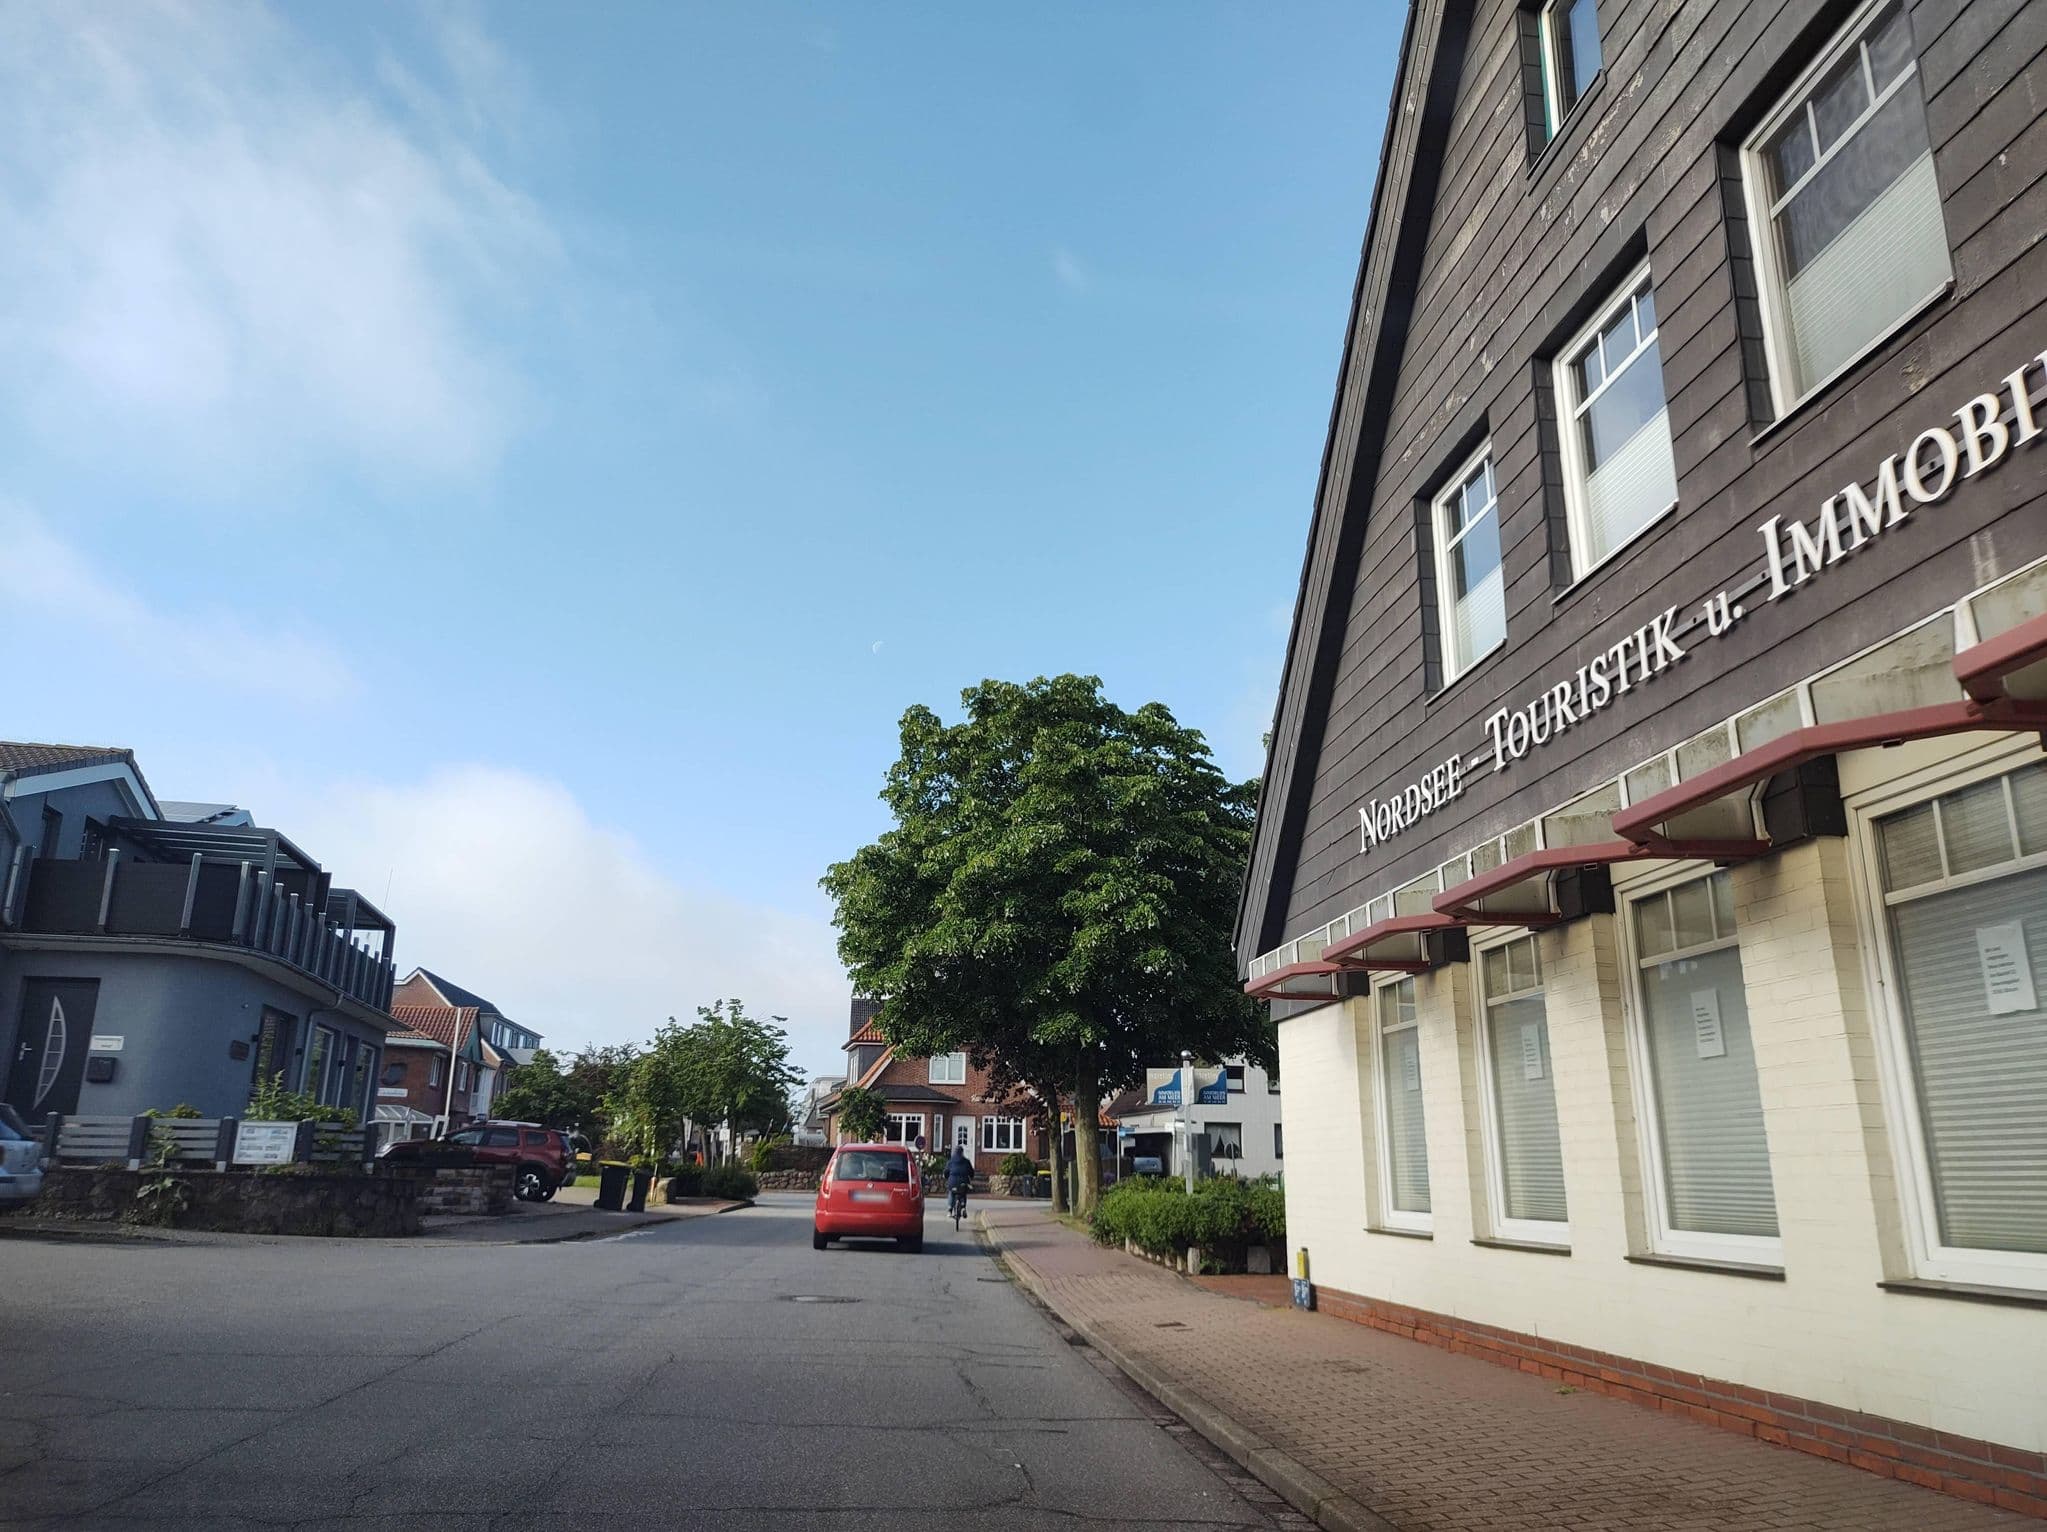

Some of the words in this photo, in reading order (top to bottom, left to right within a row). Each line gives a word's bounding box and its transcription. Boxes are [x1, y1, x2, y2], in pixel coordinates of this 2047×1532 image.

[1359, 754, 1463, 854] NORDSEE
[1484, 604, 1686, 772] TOURISTIK
[1703, 590, 1745, 637] u.
[1757, 349, 2047, 601] IMMOBI
